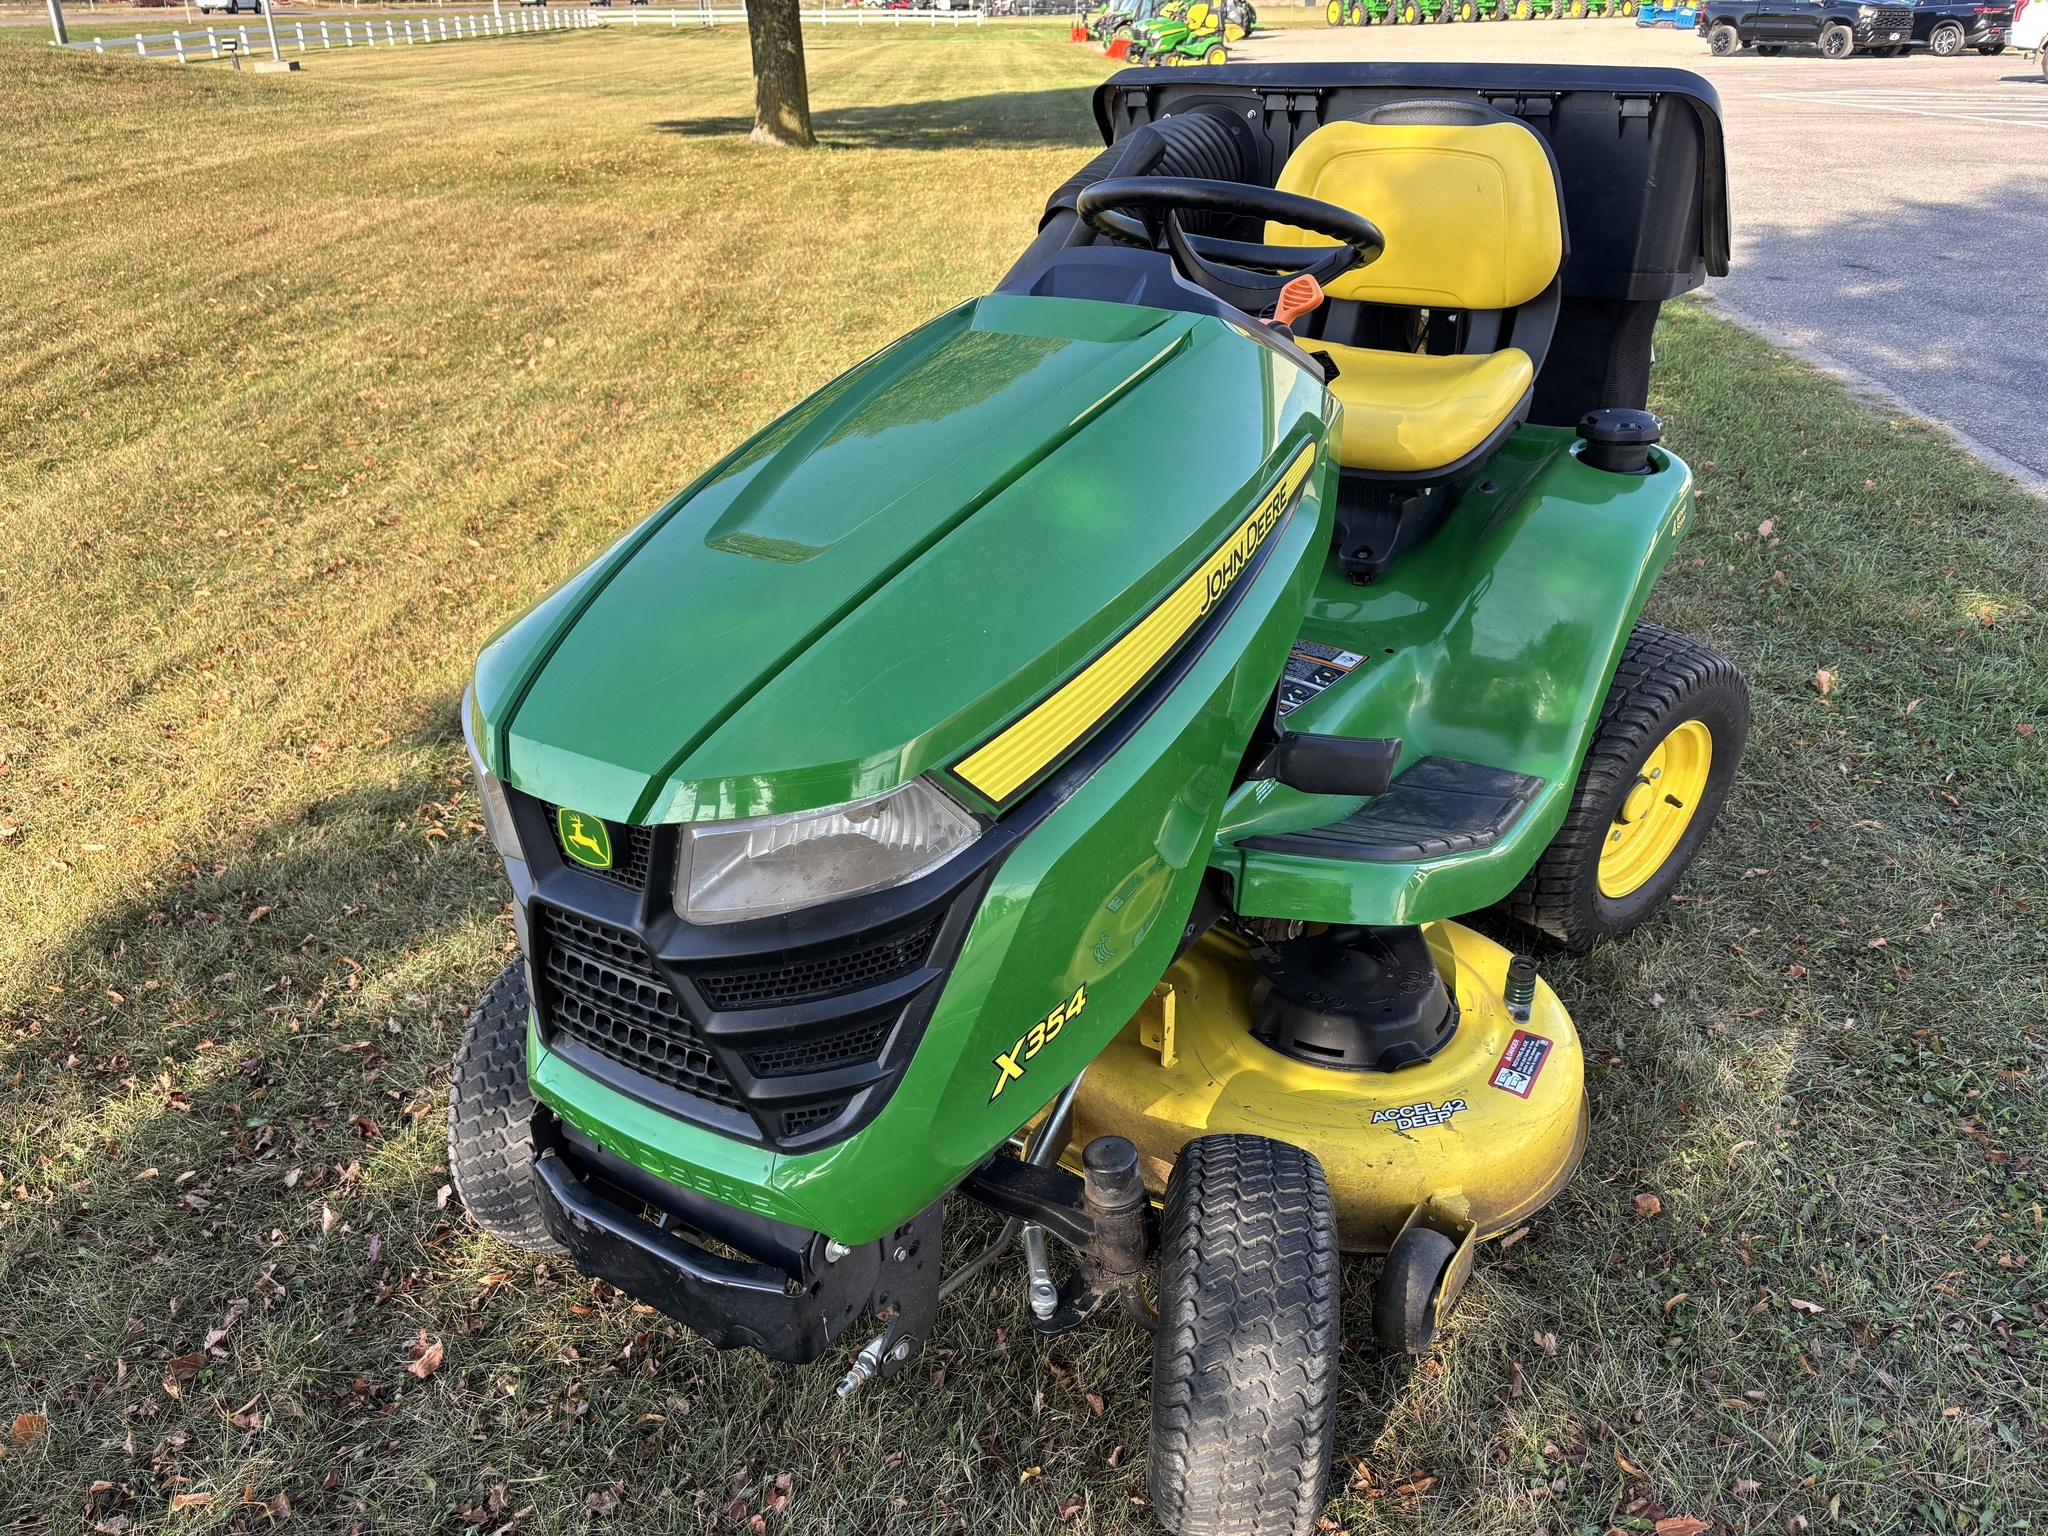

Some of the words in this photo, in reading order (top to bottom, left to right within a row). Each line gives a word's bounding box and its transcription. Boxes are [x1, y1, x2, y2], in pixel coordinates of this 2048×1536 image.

[1201, 539, 1245, 615] JOHN
[1246, 481, 1289, 559] DEERE
[986, 981, 1088, 1106] X354
[1506, 1038, 1520, 1056] DANGER
[548, 1091, 631, 1159] JOHN
[630, 1140, 777, 1216] DEERE
[1397, 1111, 1452, 1131] DEEP
